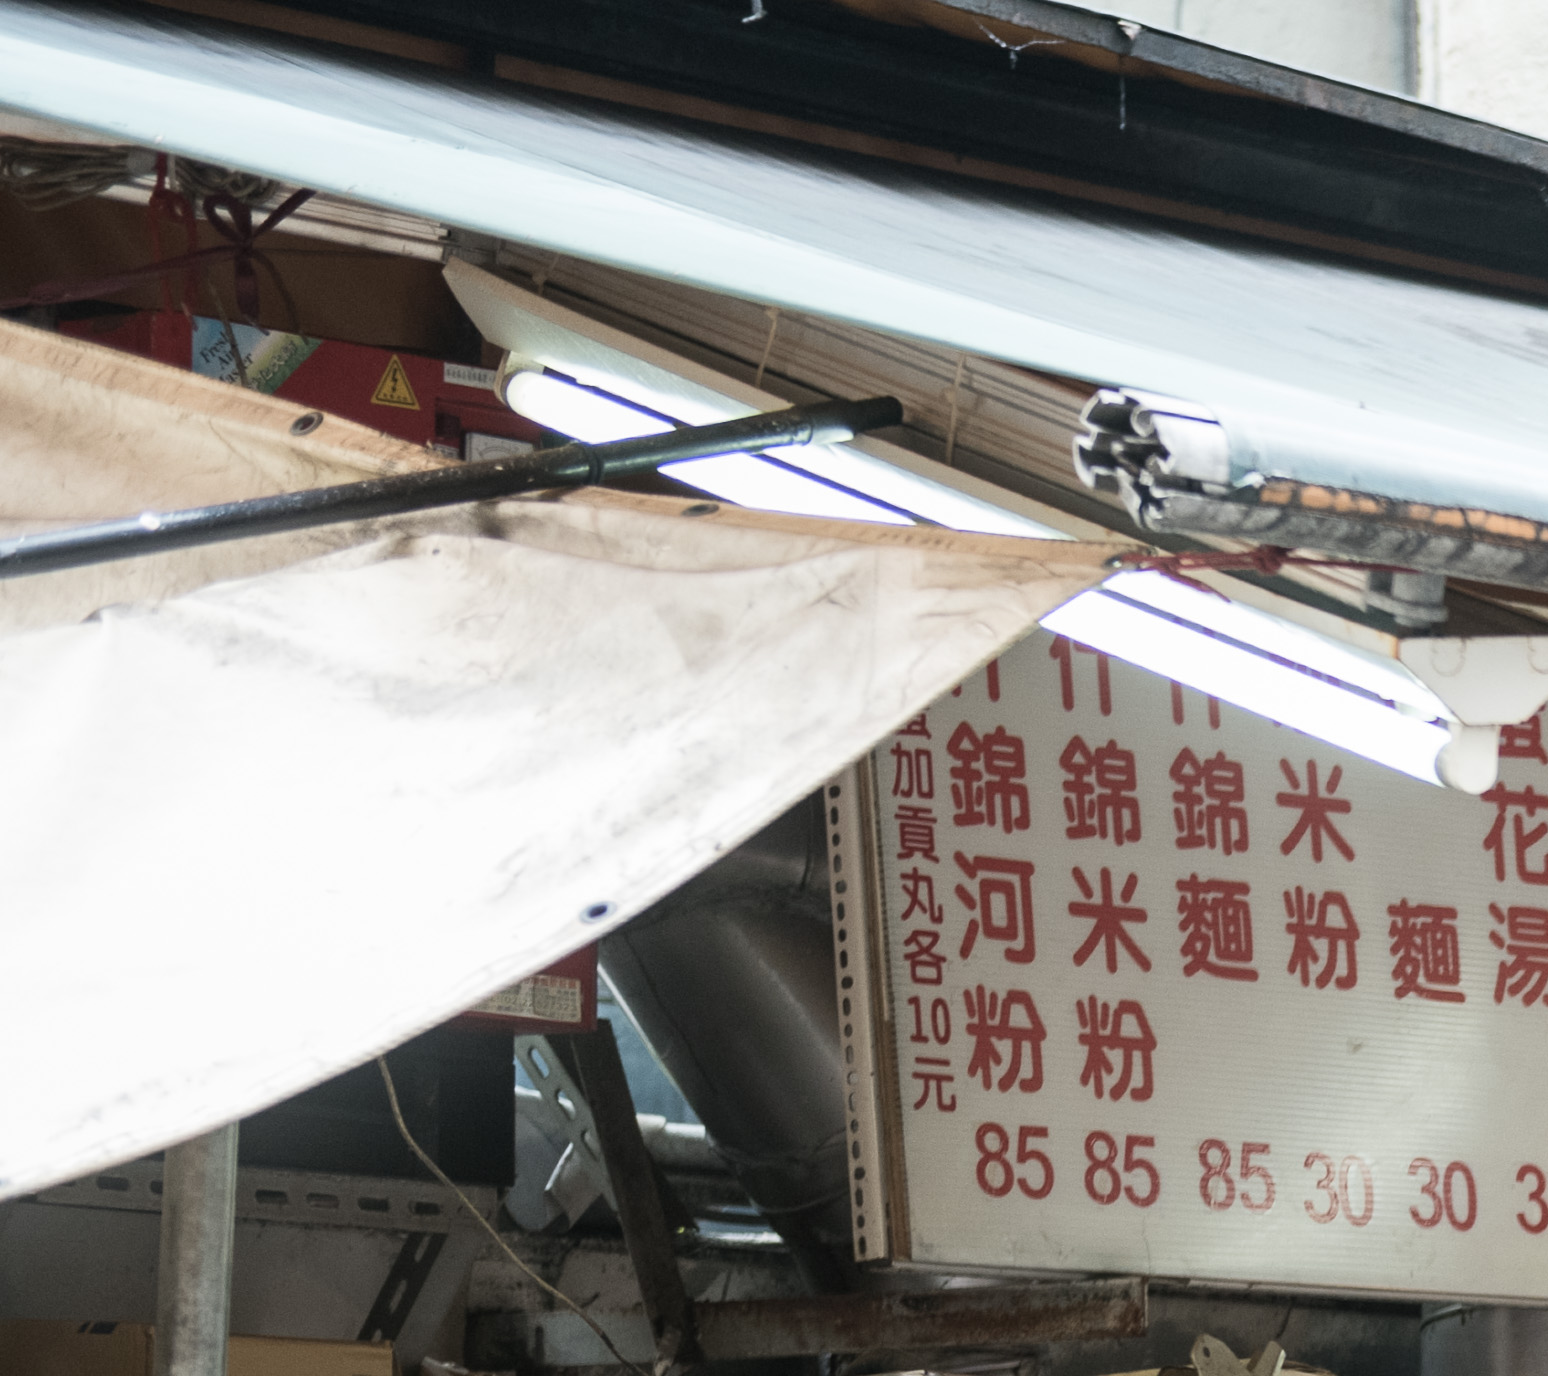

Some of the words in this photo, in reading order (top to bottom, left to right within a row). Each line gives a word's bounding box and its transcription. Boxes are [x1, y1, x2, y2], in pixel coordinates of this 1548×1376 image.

[974, 1122, 1055, 1200] 85
[1083, 1130, 1161, 1208] 85
[1199, 1138, 1276, 1214] 85
[1303, 1152, 1375, 1227] 30
[1408, 1157, 1478, 1232] 30
